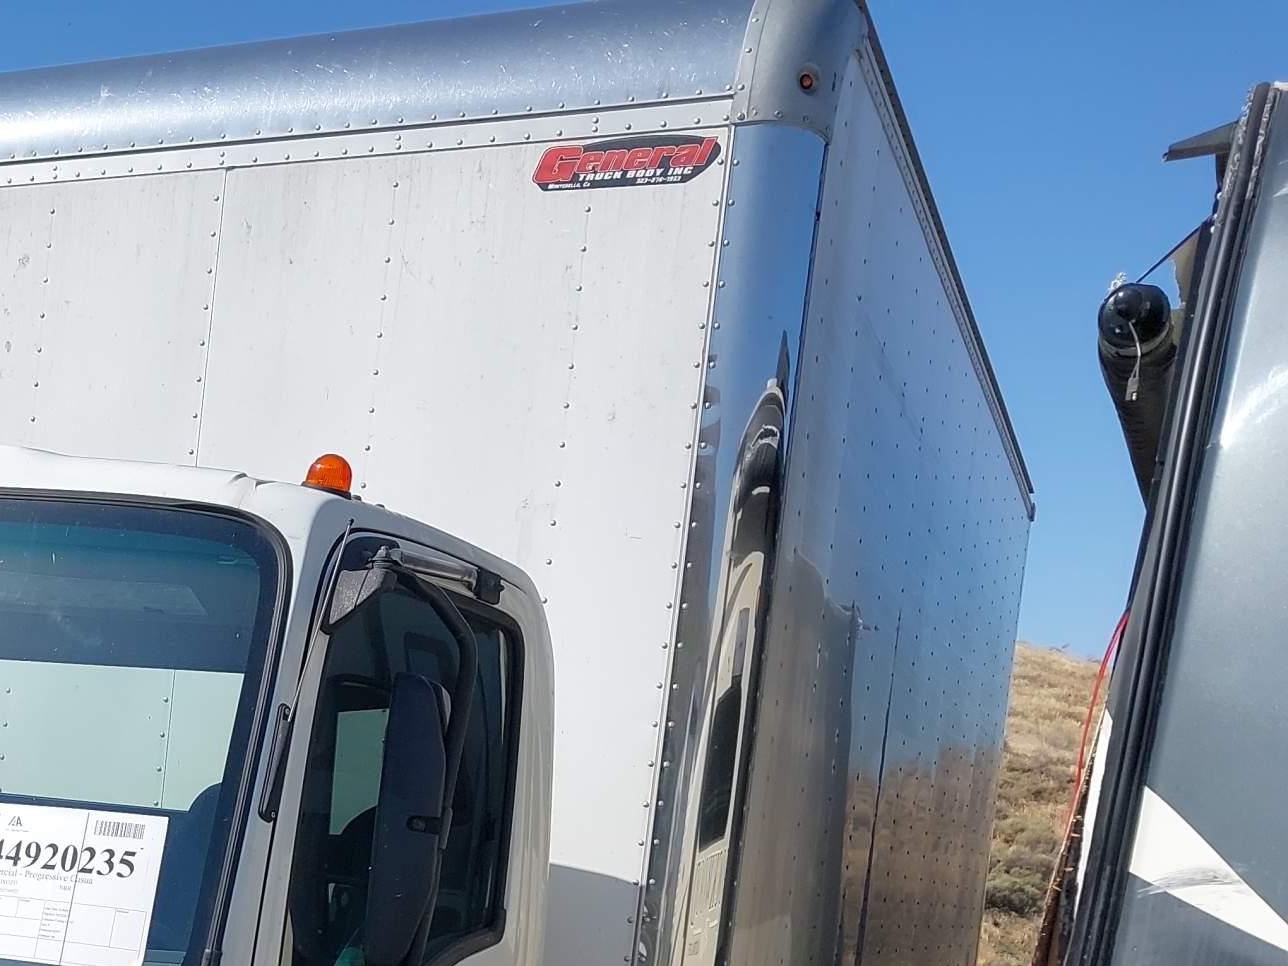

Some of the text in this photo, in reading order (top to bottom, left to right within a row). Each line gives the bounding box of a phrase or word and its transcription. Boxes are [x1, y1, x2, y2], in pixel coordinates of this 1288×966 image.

[532, 136, 718, 183] General
[578, 165, 694, 181] TRUCK BODY INC
[24, 869, 69, 883] Progressive
